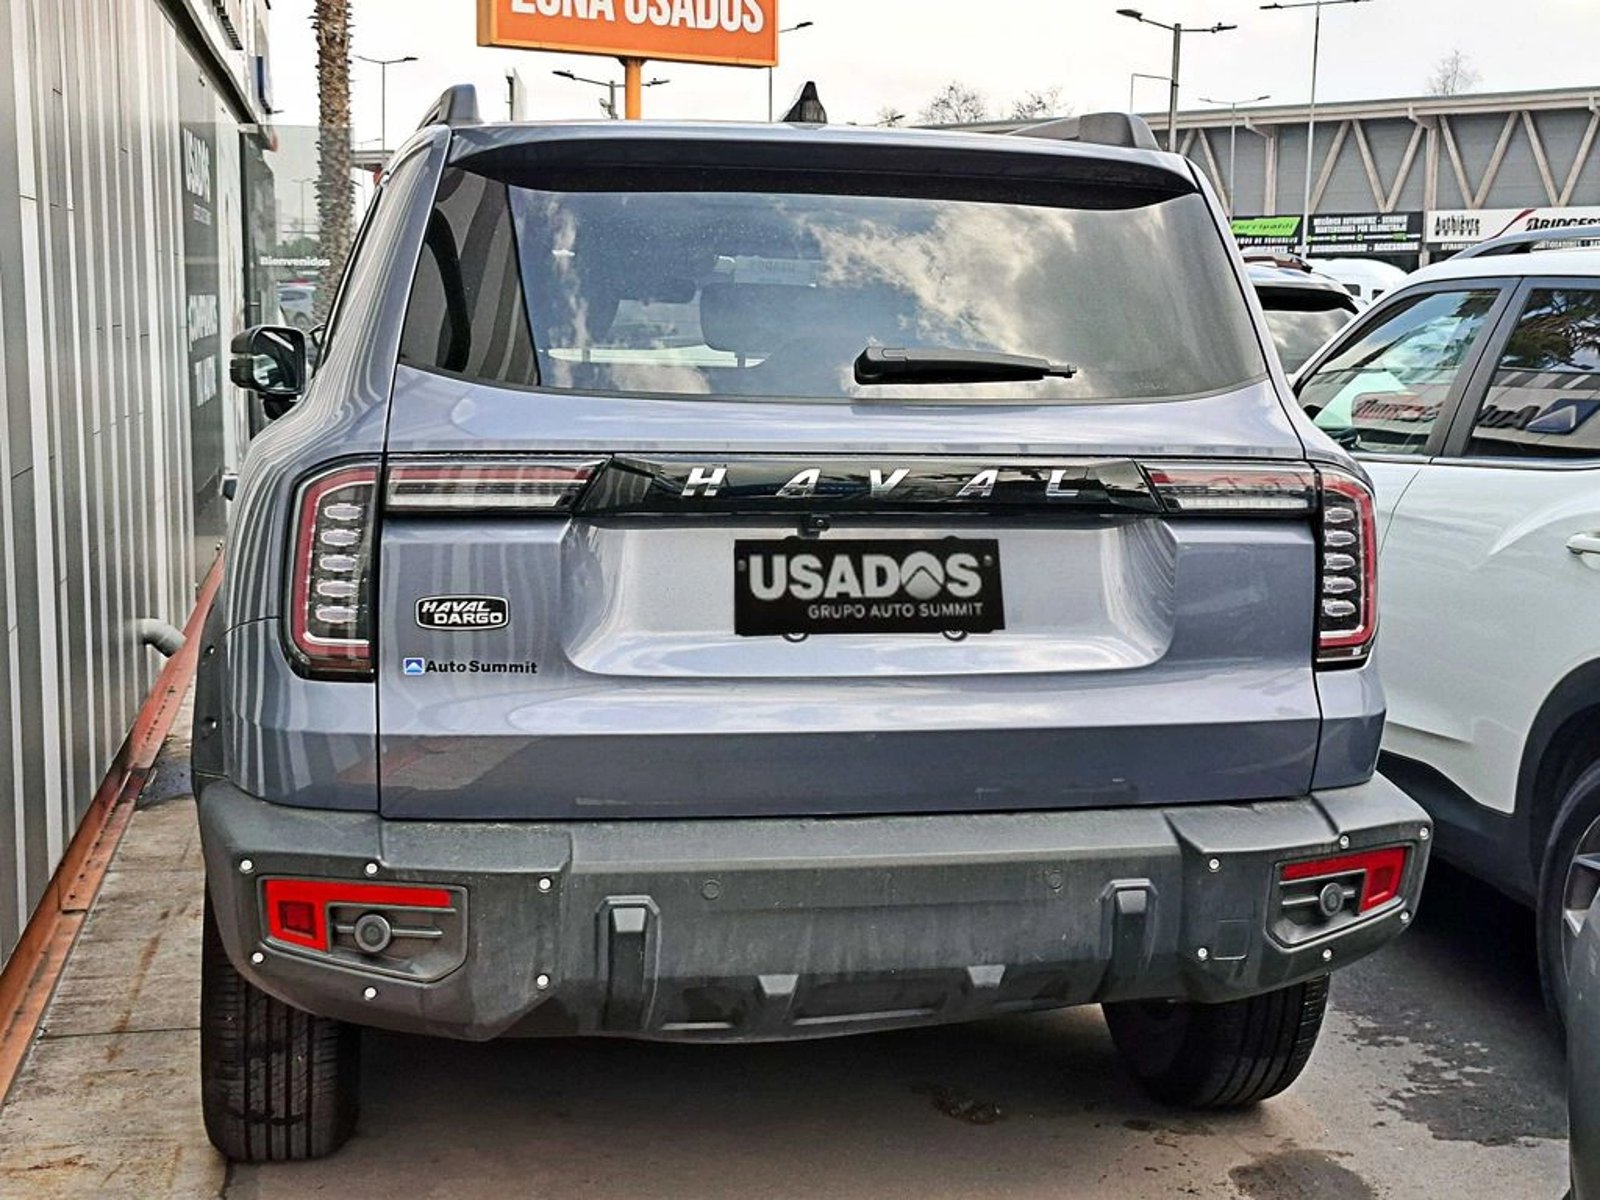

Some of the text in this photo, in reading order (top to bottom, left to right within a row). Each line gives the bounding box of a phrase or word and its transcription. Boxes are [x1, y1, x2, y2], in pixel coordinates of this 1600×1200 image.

[624, 0, 764, 33] USADOS
[260, 255, 331, 267] Bienvenidos
[681, 467, 1080, 497] HAVAL
[750, 551, 982, 600] USADOS
[421, 601, 491, 613] HAVAL
[808, 602, 983, 619] GRUPO AUTO SUMMIT
[433, 612, 503, 624] DARGO
